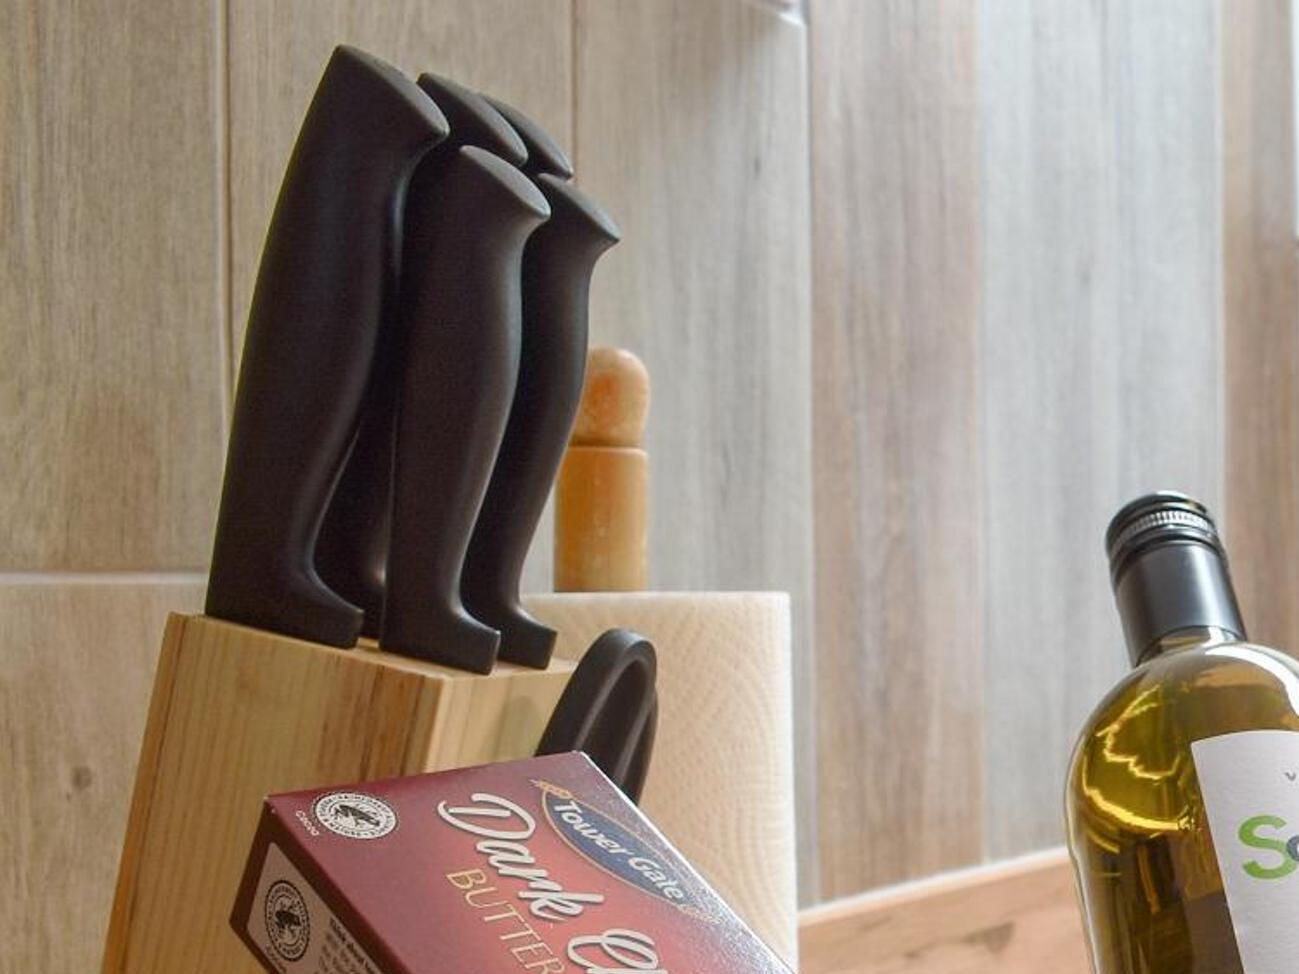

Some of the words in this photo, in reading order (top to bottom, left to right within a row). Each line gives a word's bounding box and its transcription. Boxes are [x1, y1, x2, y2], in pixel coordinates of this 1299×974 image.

[437, 792, 604, 921] Dark
[553, 800, 635, 856] Tower
[627, 856, 685, 900] Gate
